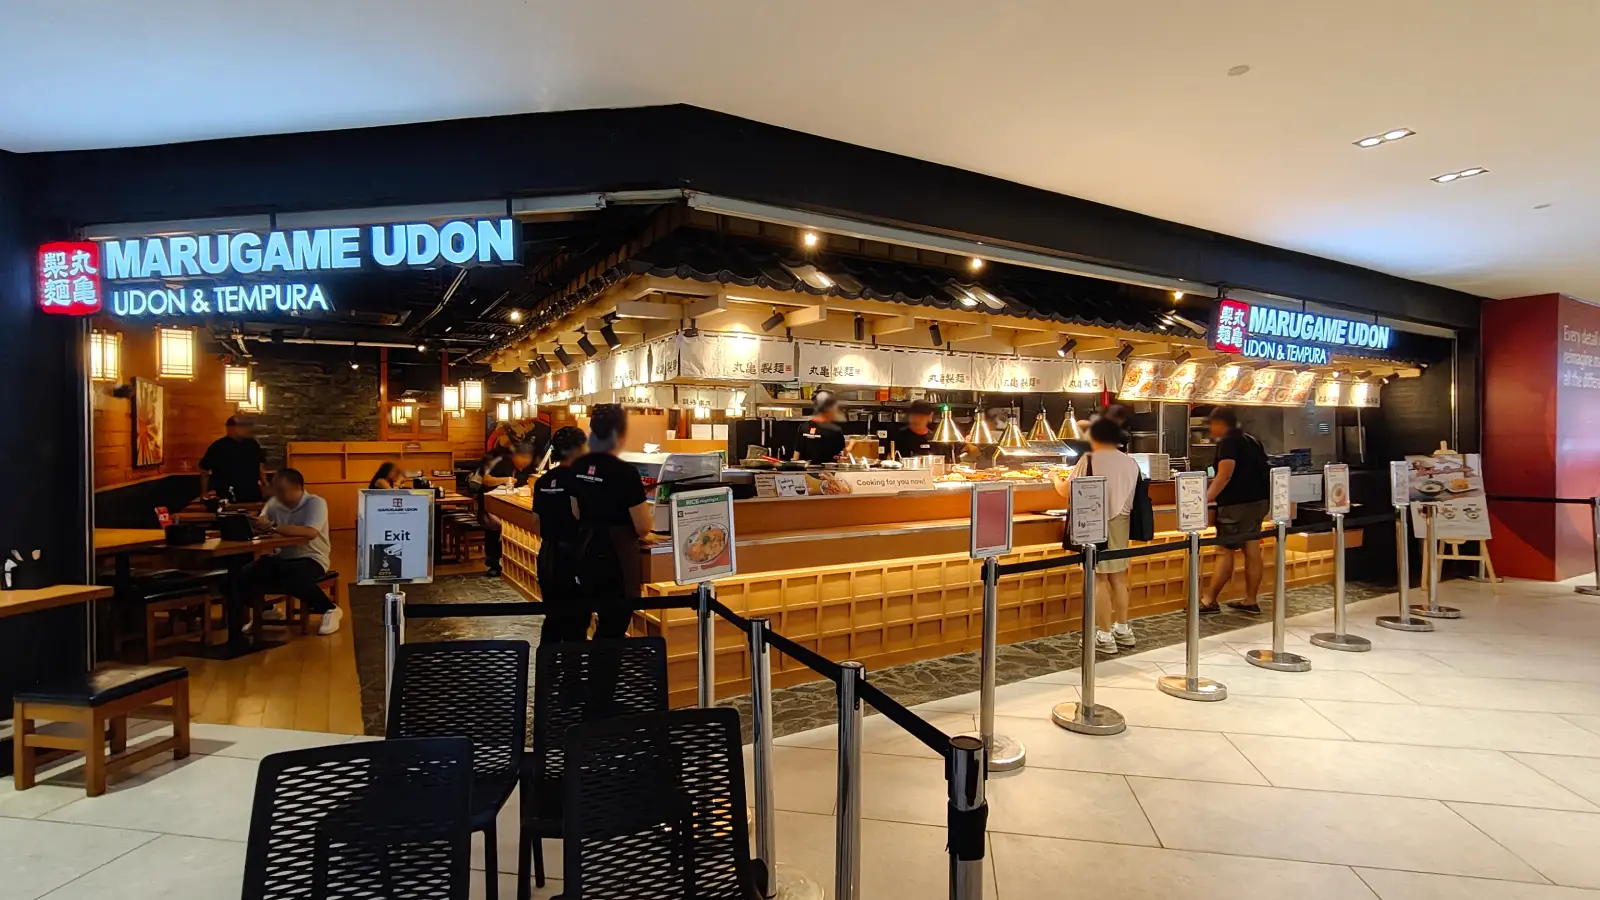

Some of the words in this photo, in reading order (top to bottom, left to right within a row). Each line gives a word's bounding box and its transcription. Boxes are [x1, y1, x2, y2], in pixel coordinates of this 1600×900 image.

[105, 227, 361, 279] MARUGAME
[371, 218, 514, 267] UDON
[113, 289, 187, 316] UDON
[191, 290, 210, 313] &
[215, 283, 329, 313] TEMPURA
[1249, 305, 1348, 345] MARUGAME
[1348, 322, 1390, 349] UDON
[1243, 339, 1276, 359] UDON
[1277, 346, 1287, 361] &
[1286, 344, 1327, 365] TEMPURA
[856, 478, 886, 488] Cooking
[886, 478, 896, 486] for
[896, 479, 910, 487] you
[384, 530, 411, 541] Exit
